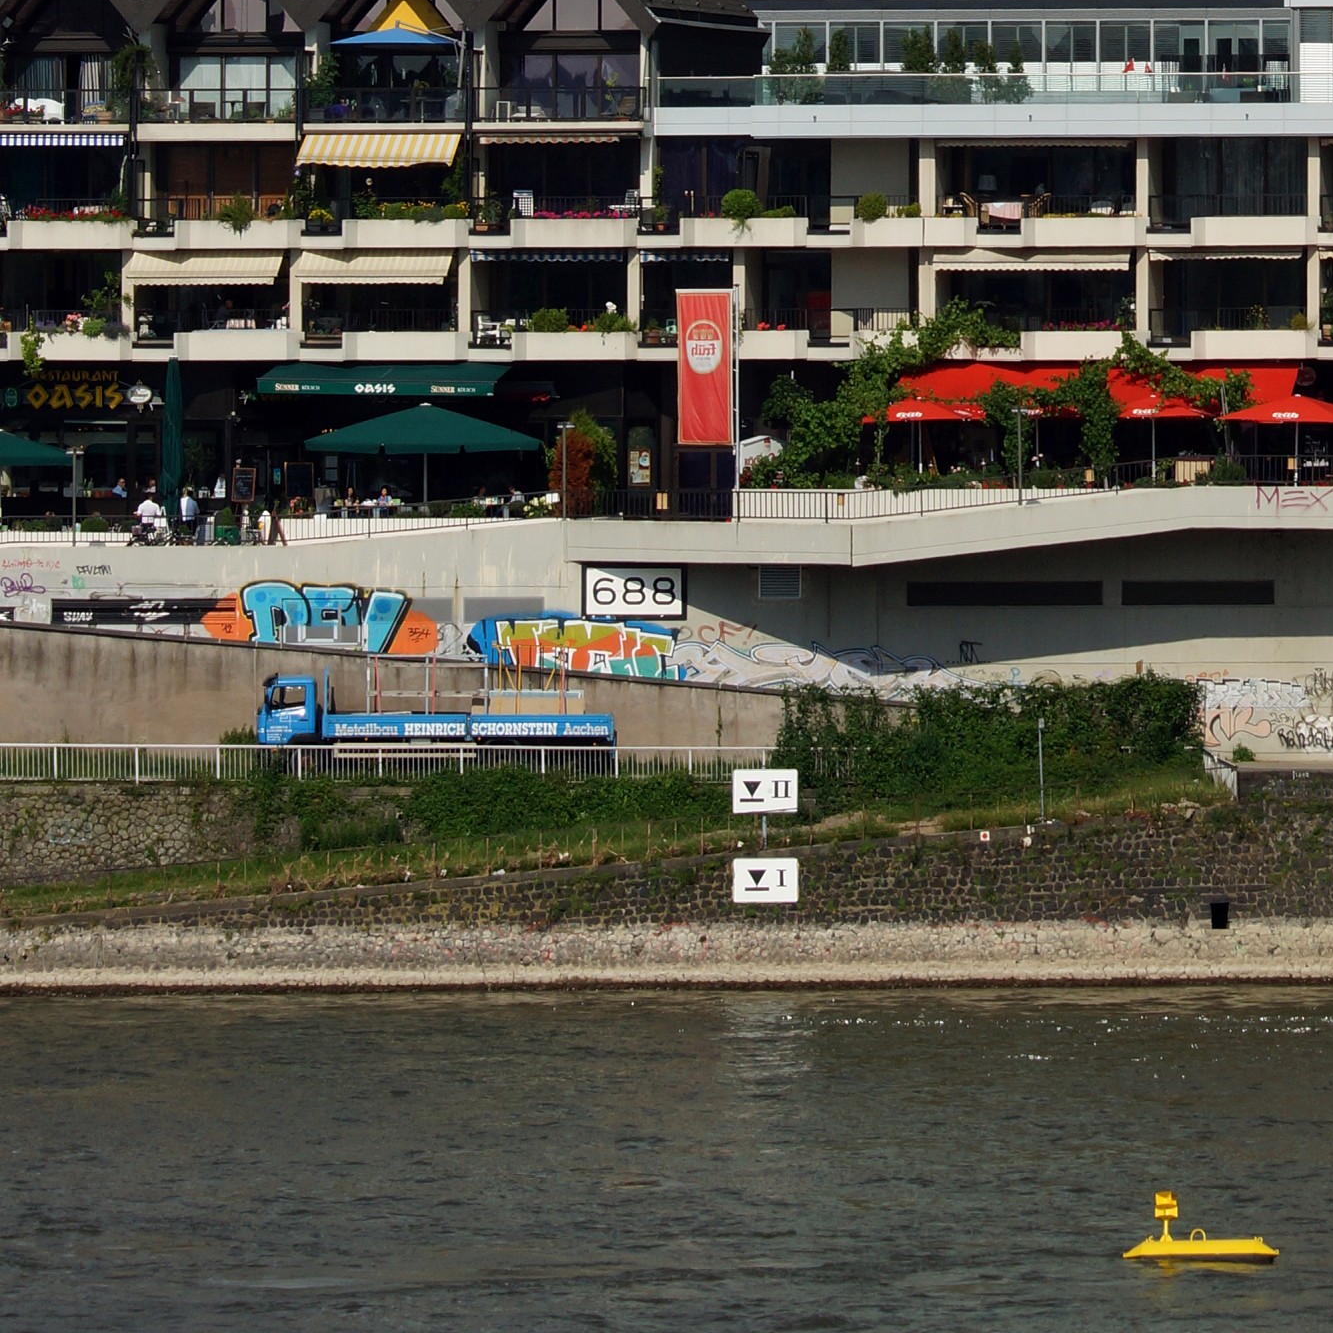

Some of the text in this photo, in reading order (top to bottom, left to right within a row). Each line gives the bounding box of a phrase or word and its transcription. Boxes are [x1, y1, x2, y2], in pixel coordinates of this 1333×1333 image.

[27, 383, 124, 410] OASIS
[354, 383, 396, 394] OASIS
[1255, 486, 1333, 513] MEX
[592, 576, 677, 606] 688
[334, 722, 609, 736] Metallbau HEINRICH SCHORNSTEIN Aachen
